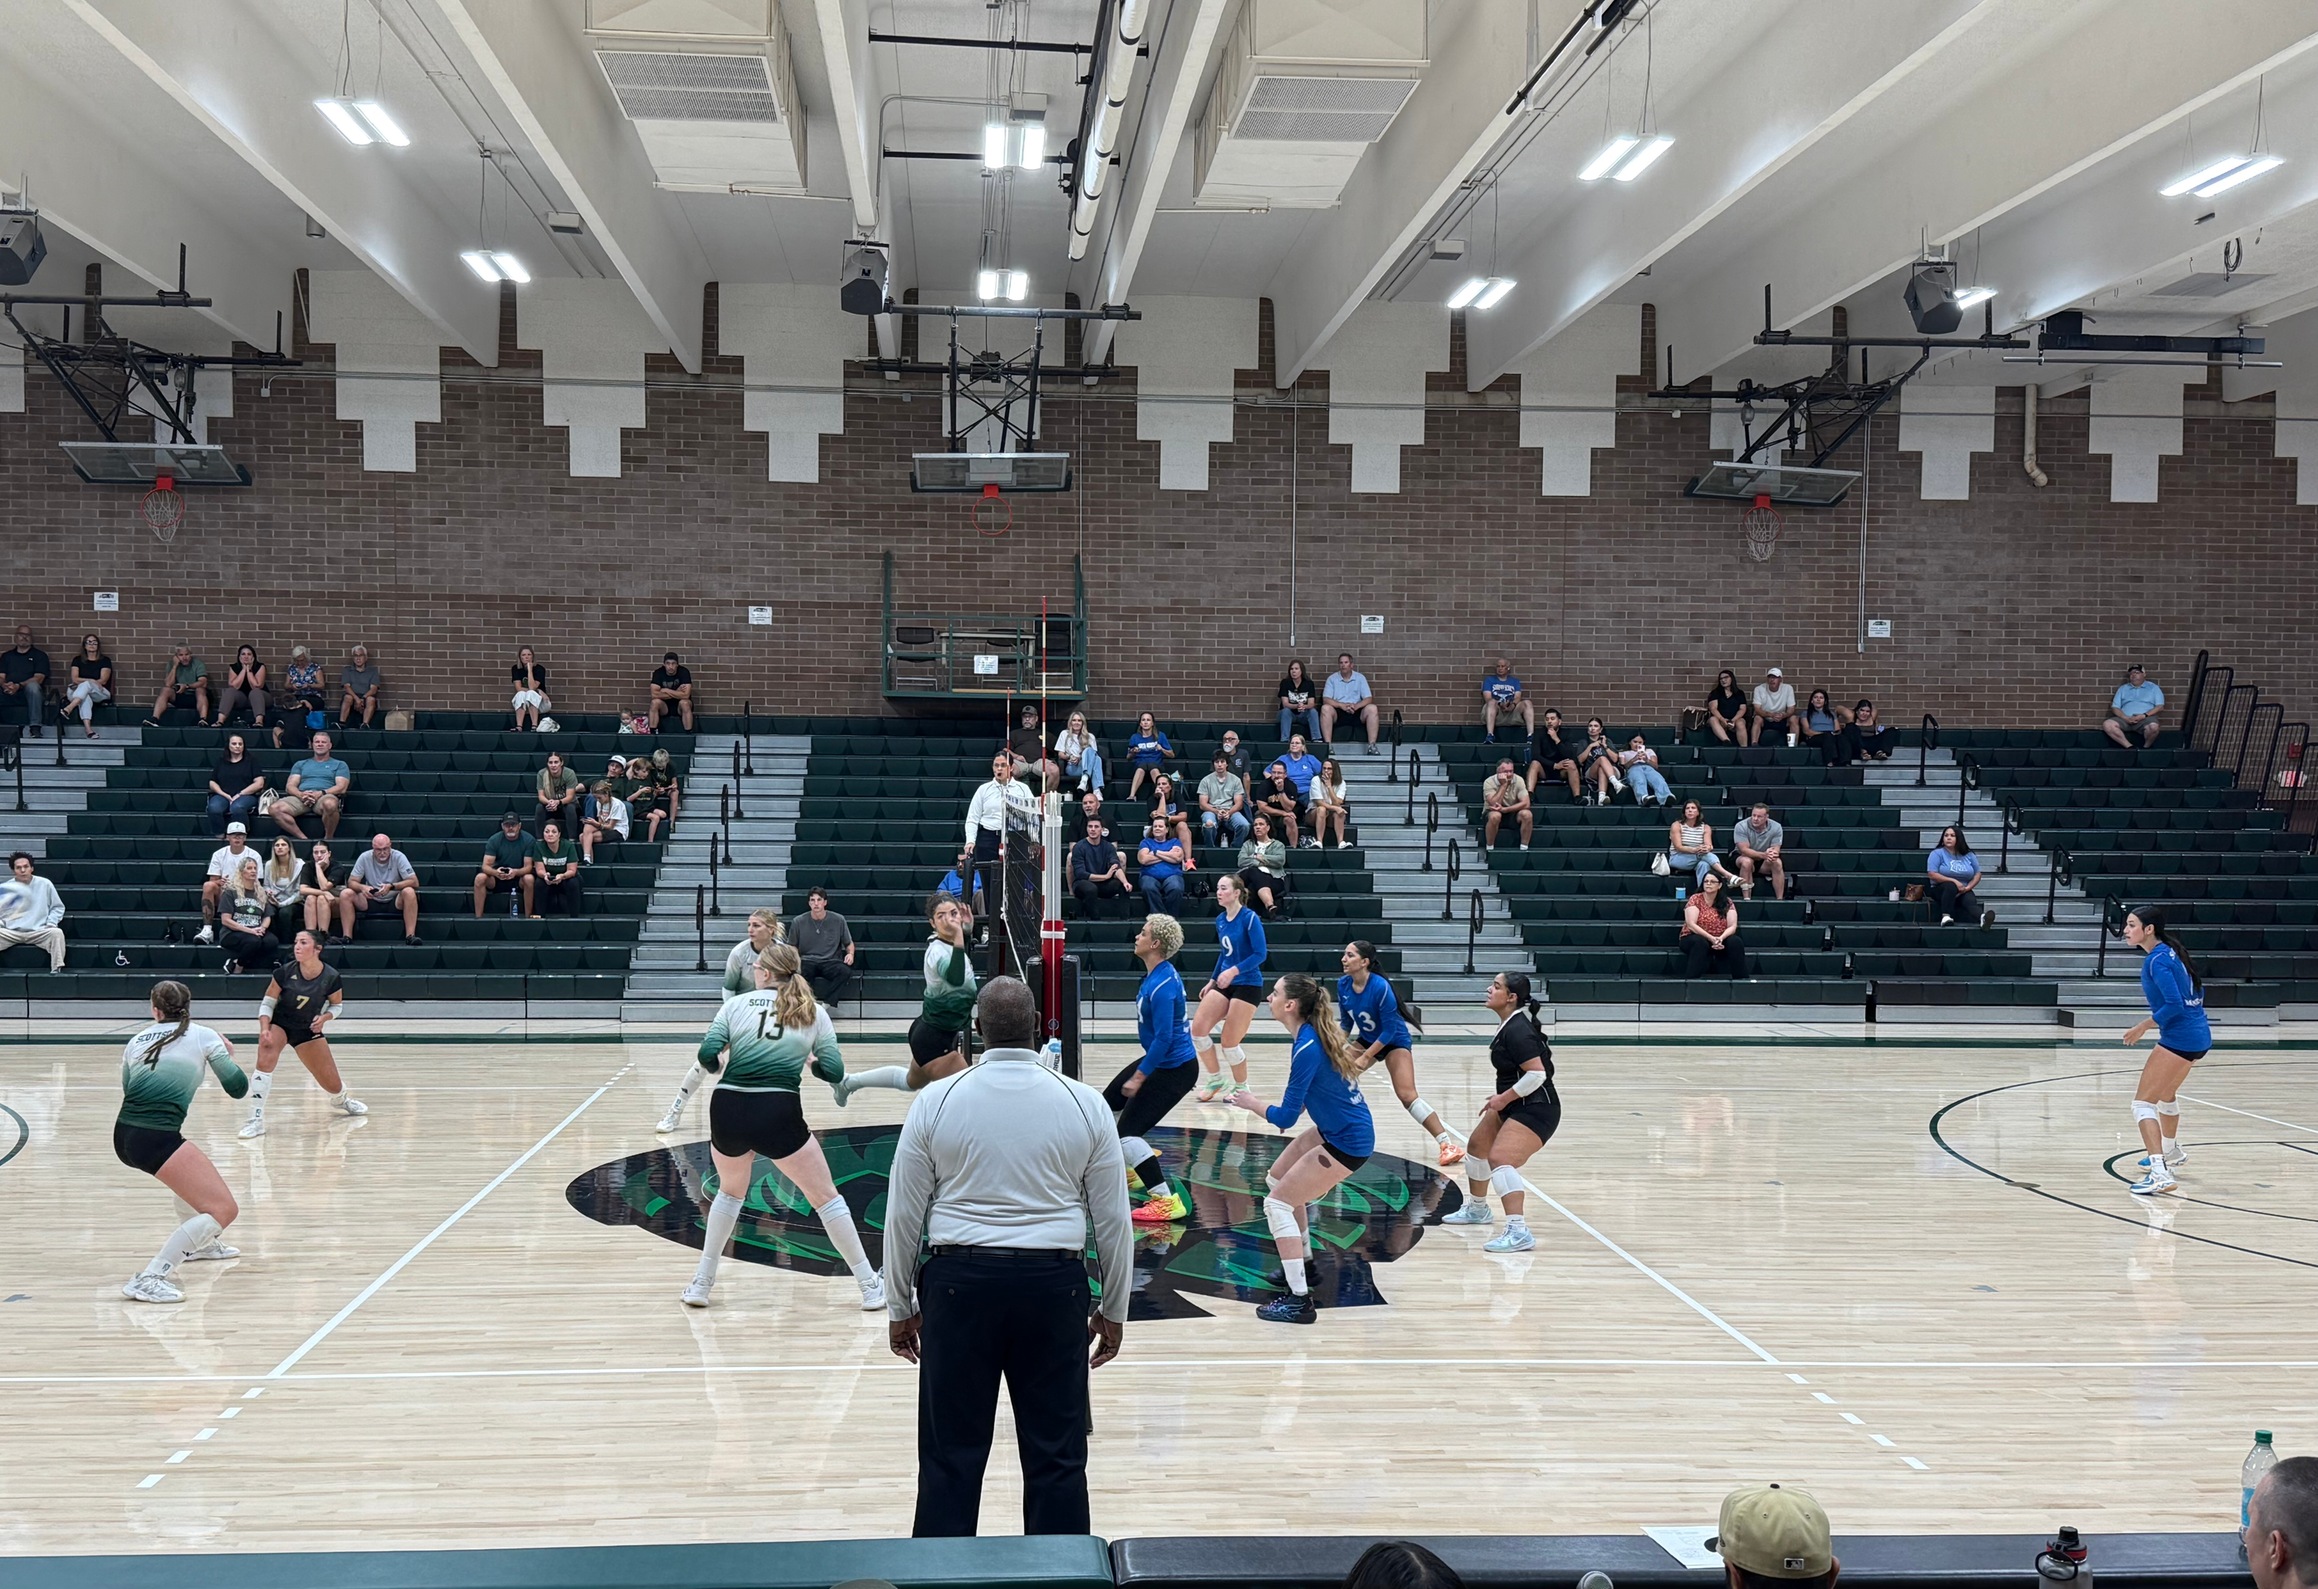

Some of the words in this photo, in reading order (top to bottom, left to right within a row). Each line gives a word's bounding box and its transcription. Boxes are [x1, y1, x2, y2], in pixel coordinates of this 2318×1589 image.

[1222, 935, 1233, 957] 9
[296, 995, 310, 1010] 7
[749, 998, 775, 1007] SCOT
[757, 1009, 784, 1040] 13
[136, 1030, 173, 1043] SCOTTS
[144, 1047, 161, 1071] 4
